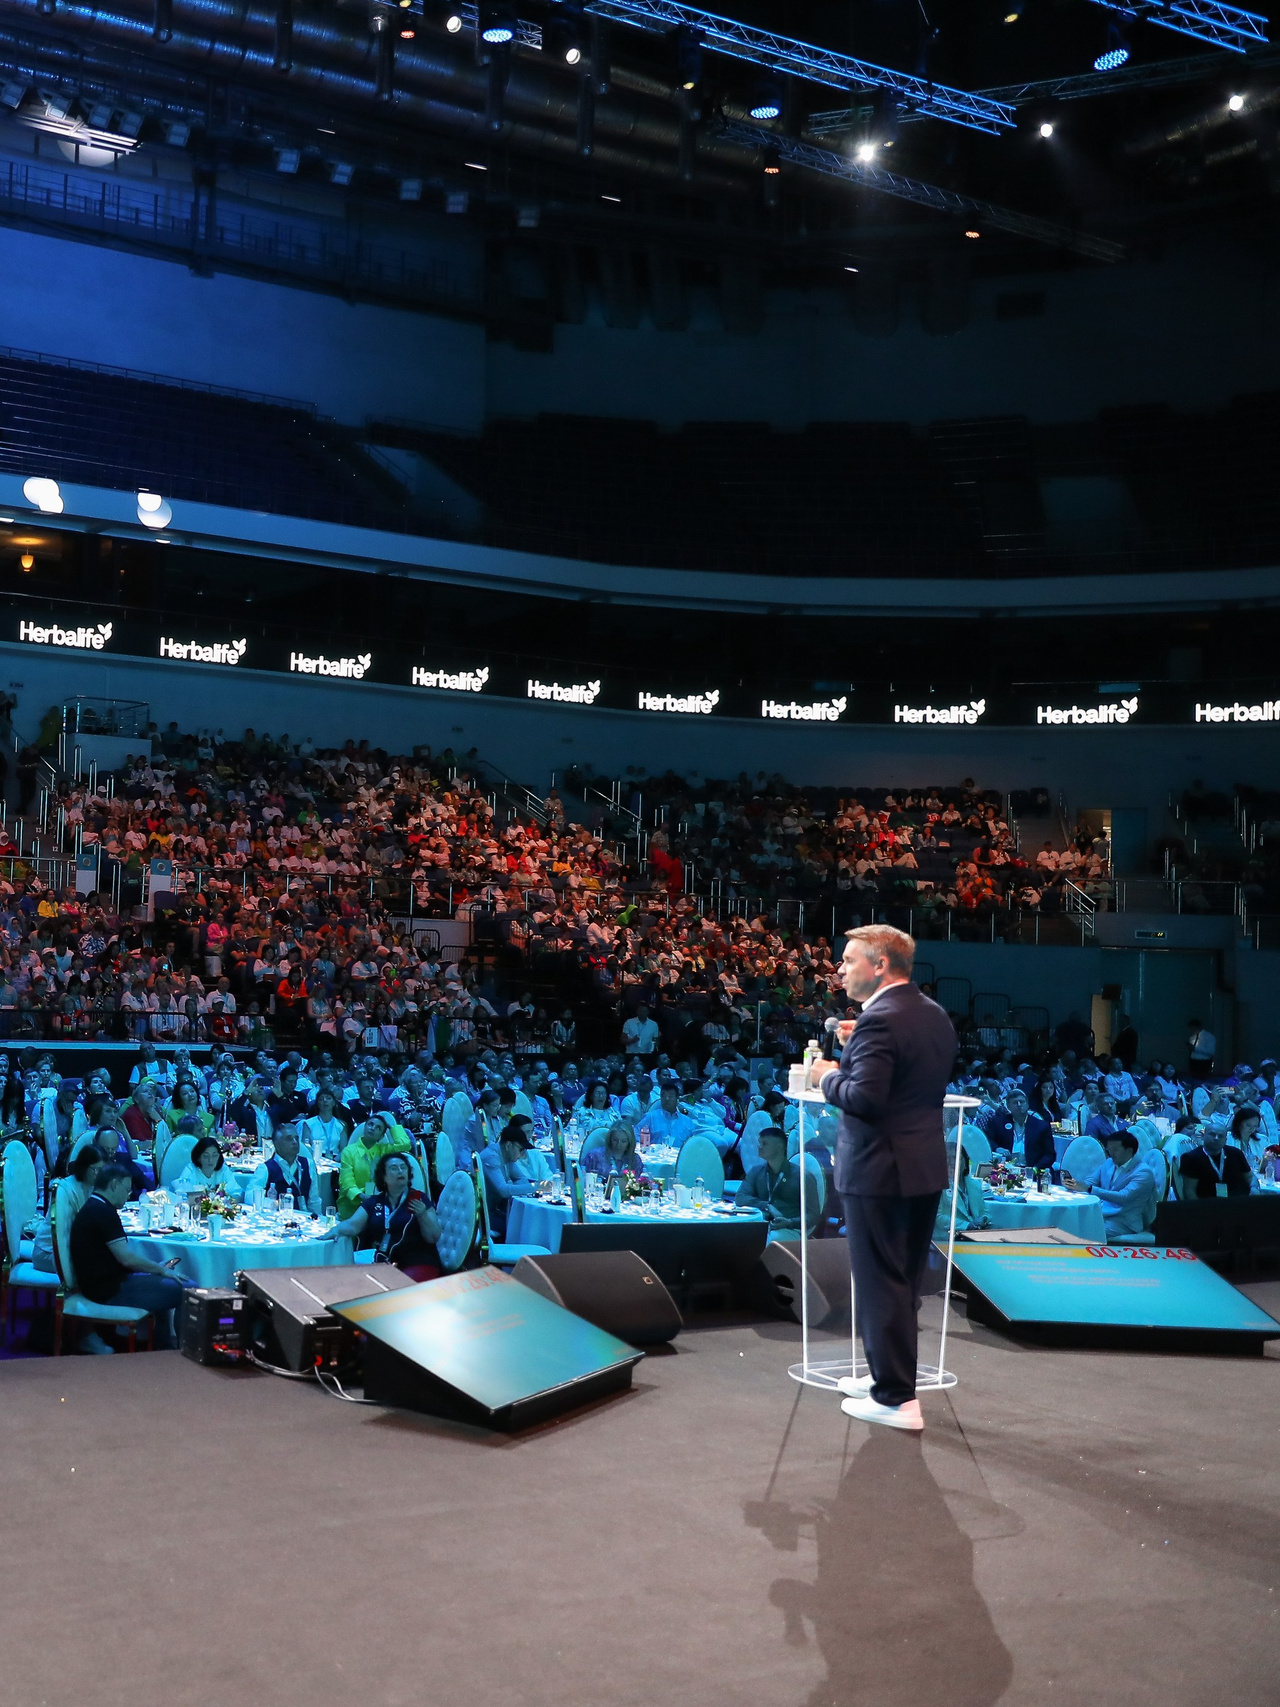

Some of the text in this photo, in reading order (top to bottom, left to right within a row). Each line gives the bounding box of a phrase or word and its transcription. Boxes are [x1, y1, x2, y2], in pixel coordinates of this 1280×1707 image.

[19, 620, 104, 650] Herbalife
[160, 636, 238, 665] Herbalife
[290, 651, 363, 679] Herbalife
[412, 666, 481, 692] Herbalife
[527, 679, 594, 705] Herbalife
[638, 692, 712, 713] Herbalife
[761, 699, 839, 721] Herbalife
[894, 704, 978, 724] Herbalife
[1037, 703, 1129, 724] Herbalife
[1195, 701, 1280, 722] Herbalif
[1084, 1245, 1200, 1263] 00:26:46
